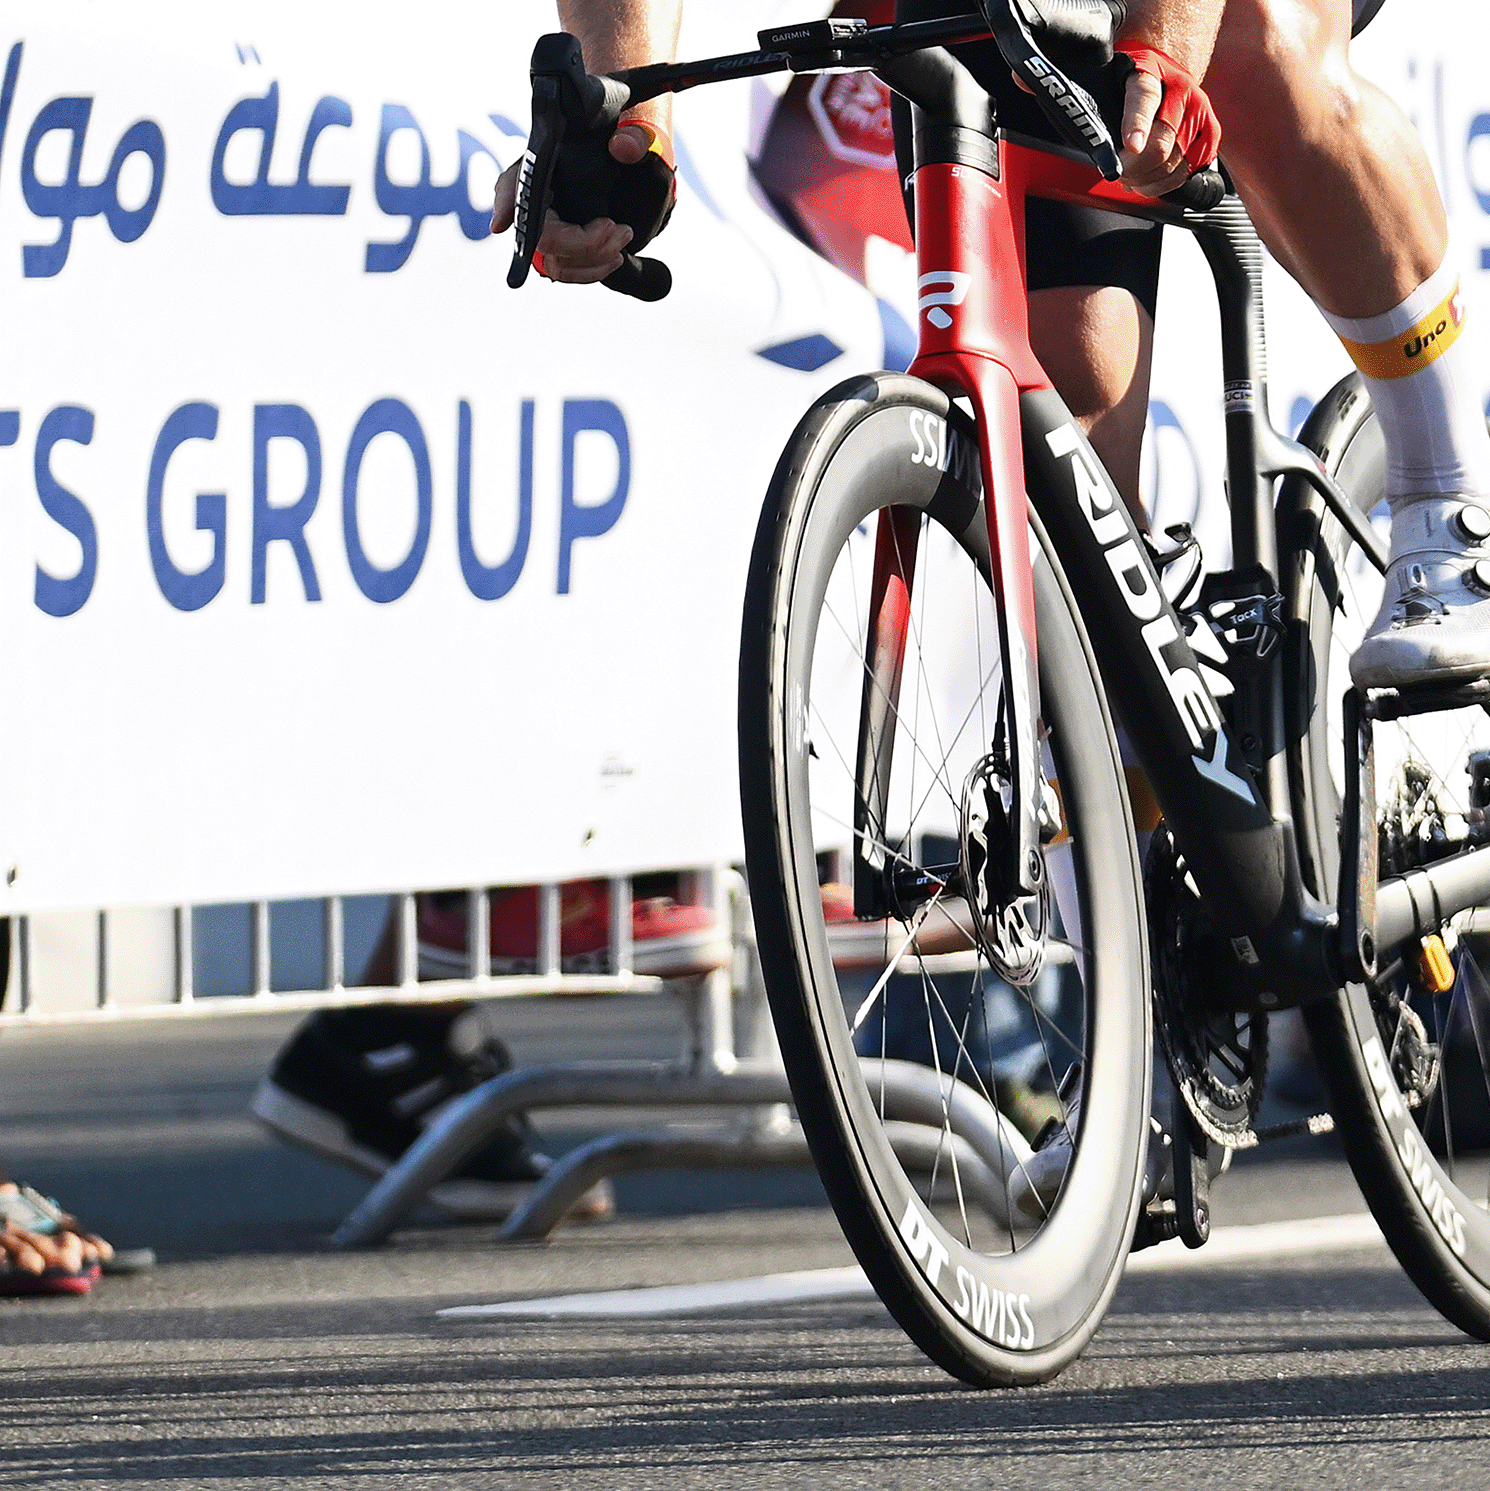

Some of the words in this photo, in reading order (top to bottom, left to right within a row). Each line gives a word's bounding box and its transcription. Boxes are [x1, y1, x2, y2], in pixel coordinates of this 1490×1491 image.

[771, 29, 811, 44] GARMIN
[1024, 56, 1106, 146] SRAM
[514, 149, 537, 257] SRAM
[1404, 319, 1447, 359] Uno
[146, 393, 632, 613] GROUP
[1045, 423, 1257, 805] RIDLEY
[1230, 607, 1258, 624] Tacx
[1398, 1128, 1467, 1257] SWISS
[900, 1197, 949, 1288] DT
[954, 1265, 1035, 1350] SWISS
